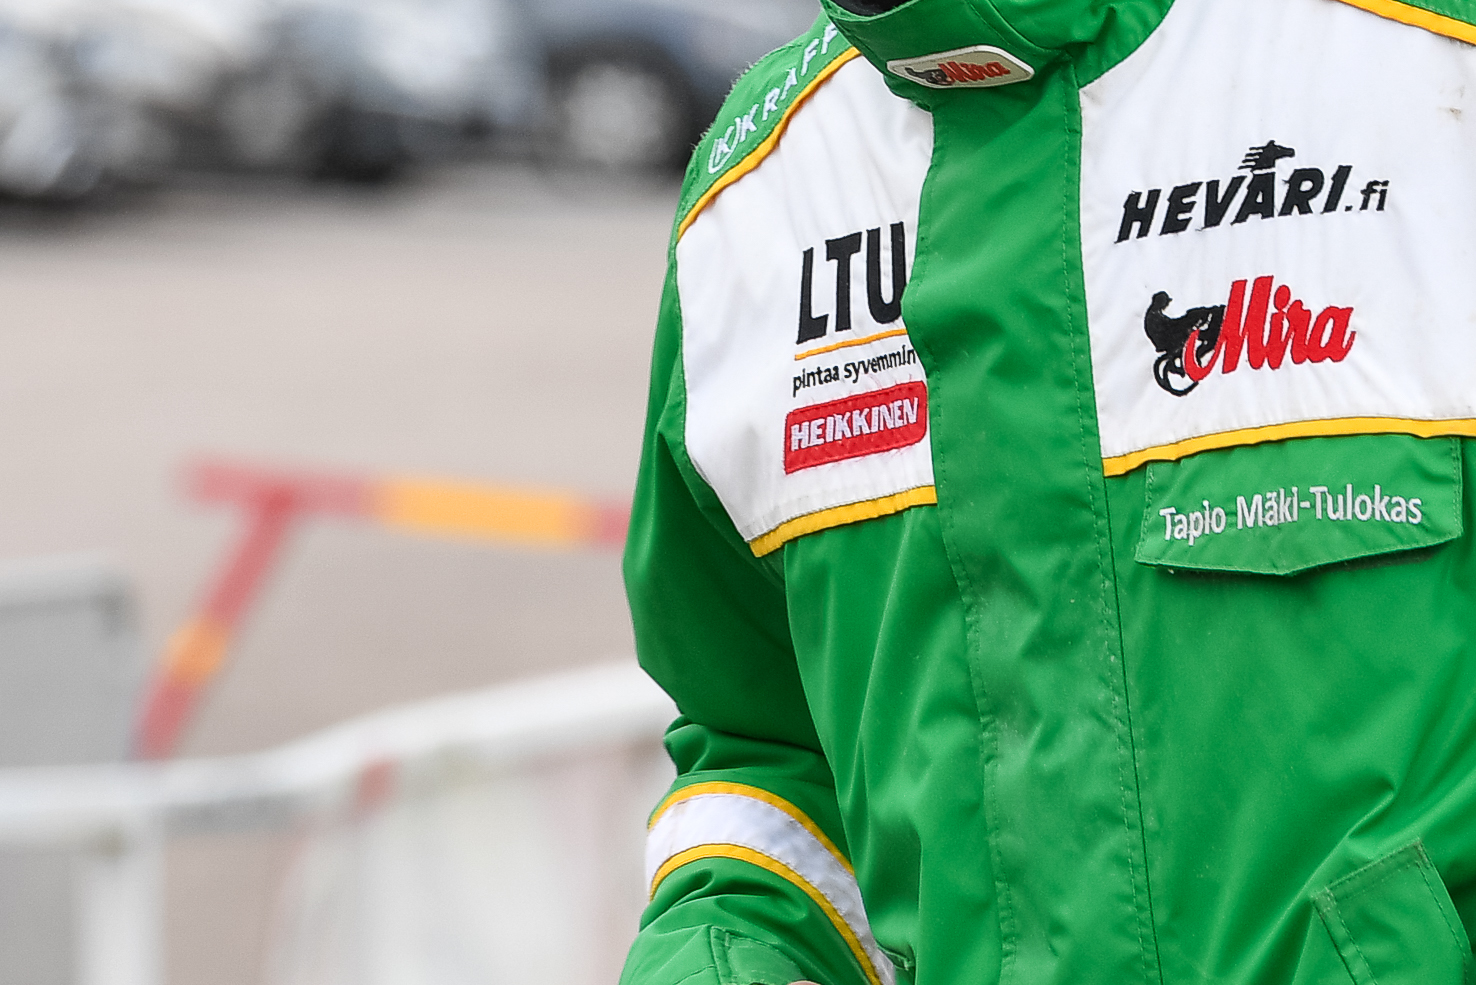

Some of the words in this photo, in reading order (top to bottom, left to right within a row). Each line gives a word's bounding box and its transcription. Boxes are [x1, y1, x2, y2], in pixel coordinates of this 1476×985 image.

[797, 221, 907, 345] LTU
[1184, 275, 1356, 382] Mira
[792, 366, 840, 398] pintaa
[844, 345, 917, 384] syvemmin
[791, 397, 919, 451] HEIKKINEN
[1160, 500, 1226, 546] Tapio
[1236, 483, 1422, 530] Mäki-Tulokas
